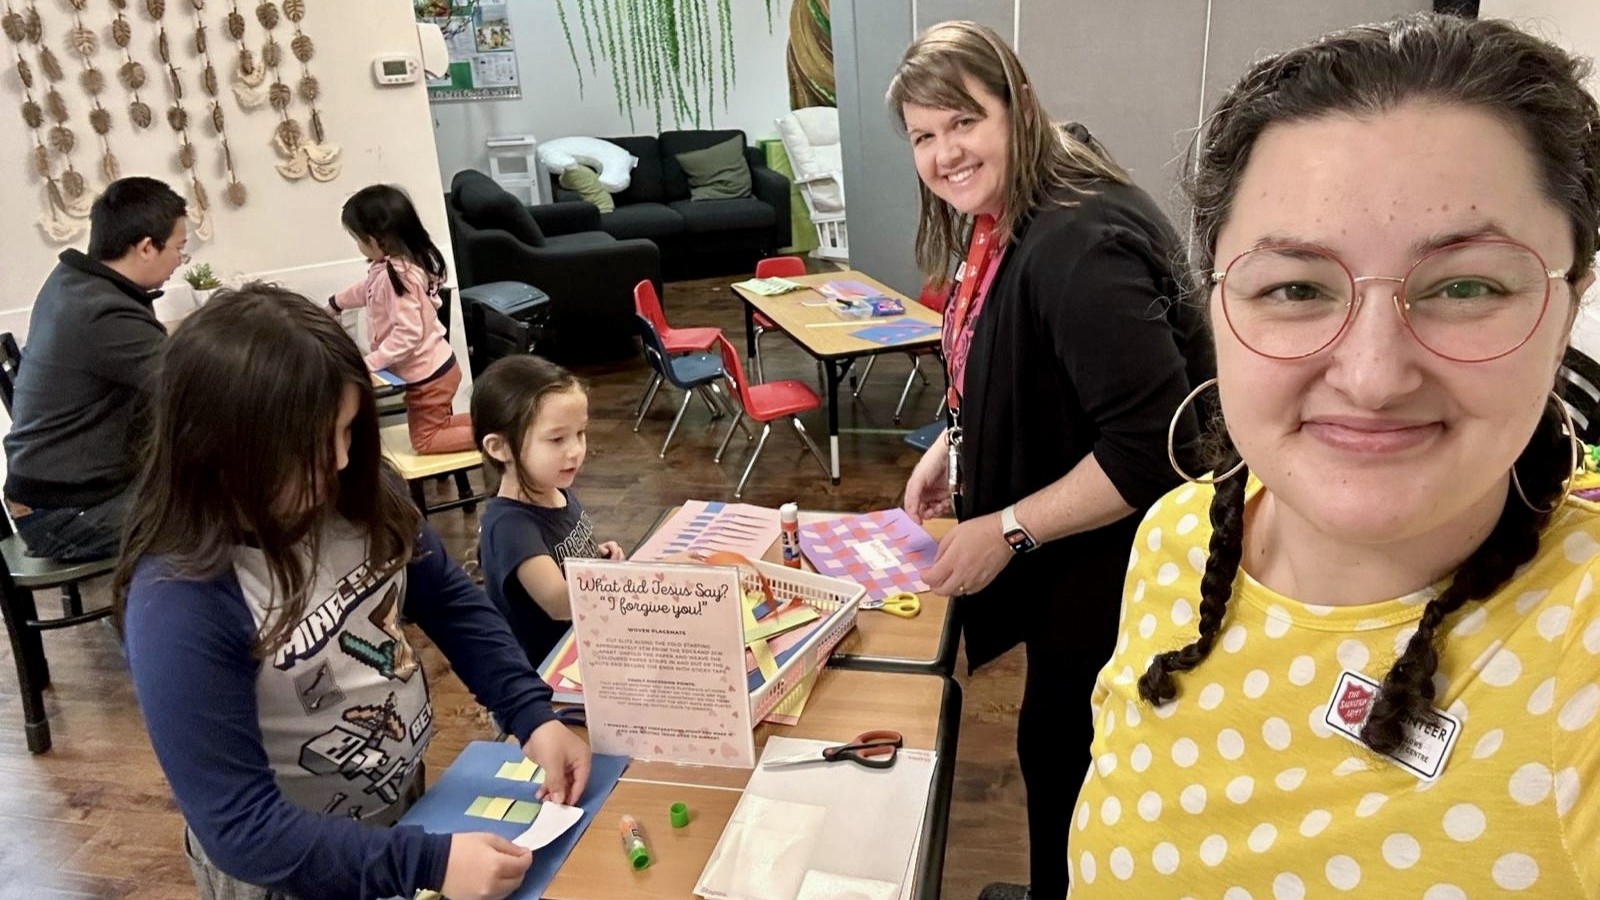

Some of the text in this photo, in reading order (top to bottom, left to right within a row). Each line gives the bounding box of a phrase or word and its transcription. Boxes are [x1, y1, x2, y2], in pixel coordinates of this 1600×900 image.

[577, 576, 729, 603] What did Jesus Say?
[274, 559, 397, 669] MINECR
[620, 598, 670, 617] forgive
[1406, 747, 1430, 763] CENTRE
